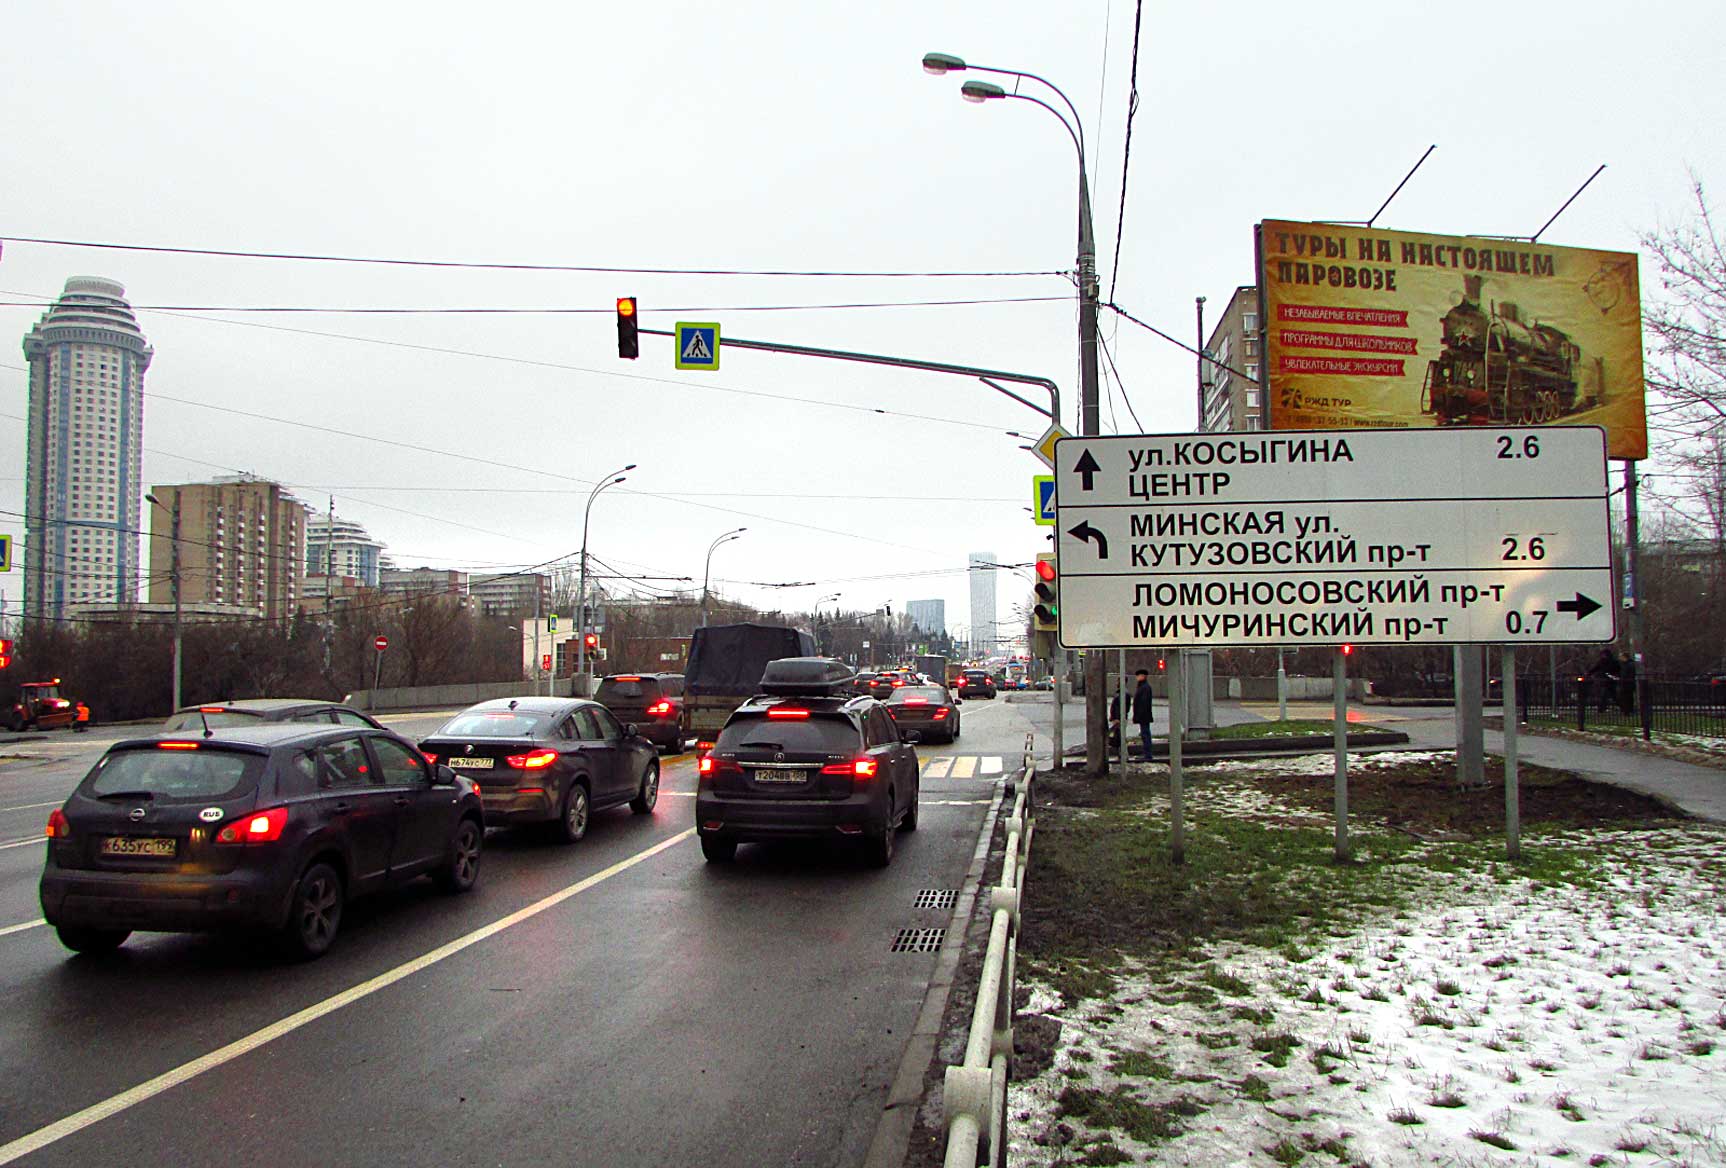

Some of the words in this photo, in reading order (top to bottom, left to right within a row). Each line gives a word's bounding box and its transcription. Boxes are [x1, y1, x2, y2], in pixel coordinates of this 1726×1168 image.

[1275, 231, 1346, 260] ТУРЫ
[1358, 238, 1392, 262] НА
[1400, 241, 1555, 277] НАСТОЯЩЕМ
[1278, 261, 1397, 291] ПАРОВОЗЕ
[1284, 332, 1334, 346] ПРОГРАММЫ
[1335, 336, 1354, 348] ДЛЯ
[1285, 359, 1352, 372] УВЛЕКАТЕЛЬНЫЕ
[1331, 398, 1352, 407] ТУР
[1497, 436, 1540, 459] 2.6
[1129, 473, 1231, 502] ЦЕНТР
[1131, 511, 1285, 537] МИНСКАЯ
[1295, 517, 1339, 540] ул.
[1132, 533, 1357, 567] КУТУЗОВСКИЙ
[1368, 544, 1431, 569] пр-т
[1503, 537, 1545, 561] 2.6
[1133, 573, 1430, 607] ЛОМОНОСОВСКИЙ
[1442, 584, 1505, 609] пр-т
[1134, 607, 1373, 638] МИЧУРИНСКИЙ
[1385, 617, 1449, 641] пр-т
[1506, 611, 1549, 635] 0.7
